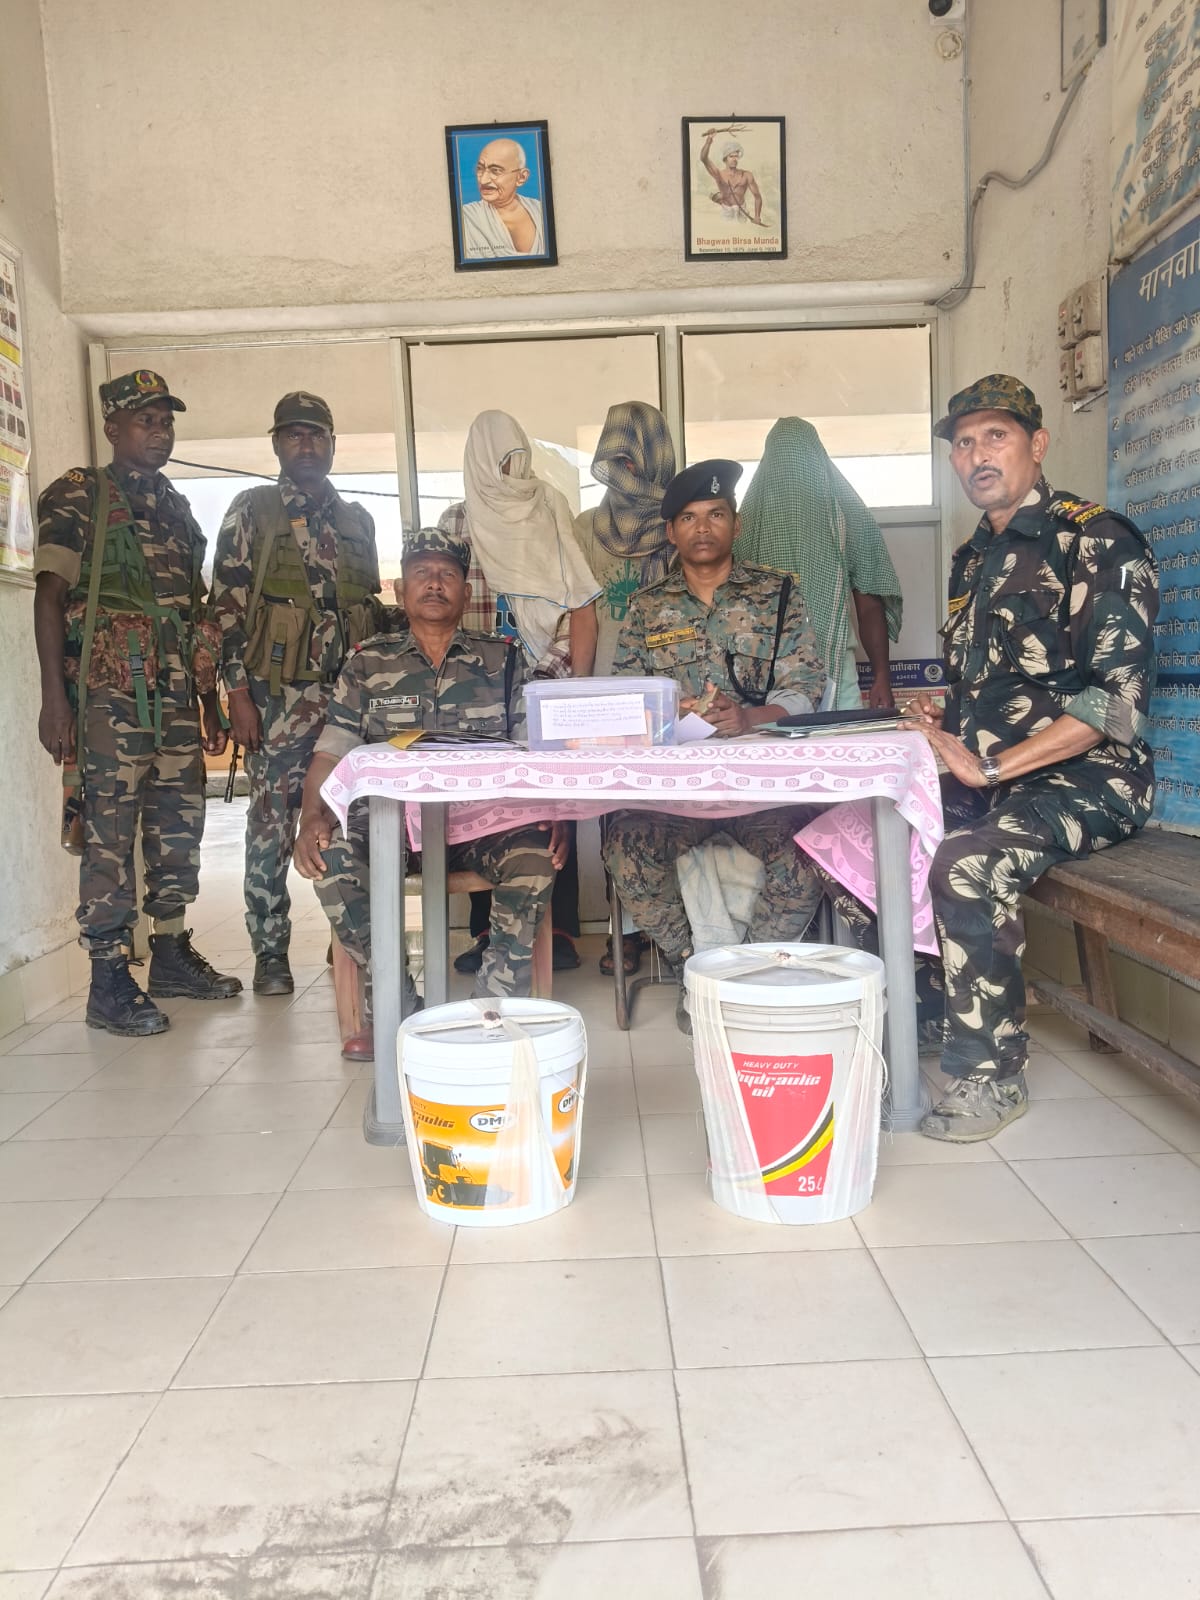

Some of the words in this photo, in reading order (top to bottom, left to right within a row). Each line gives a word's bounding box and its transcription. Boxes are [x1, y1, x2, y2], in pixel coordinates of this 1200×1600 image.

[696, 237, 730, 246] Bhagwan
[732, 236, 752, 245] Birsa
[753, 236, 779, 245] Munda
[1139, 239, 1200, 303] मानवा
[1112, 358, 1119, 369] 1
[1112, 417, 1120, 431] 2
[1112, 449, 1120, 462] 3
[743, 1060, 772, 1069] HEAVY
[772, 1062, 799, 1070] DUTY
[752, 1086, 775, 1098] oil
